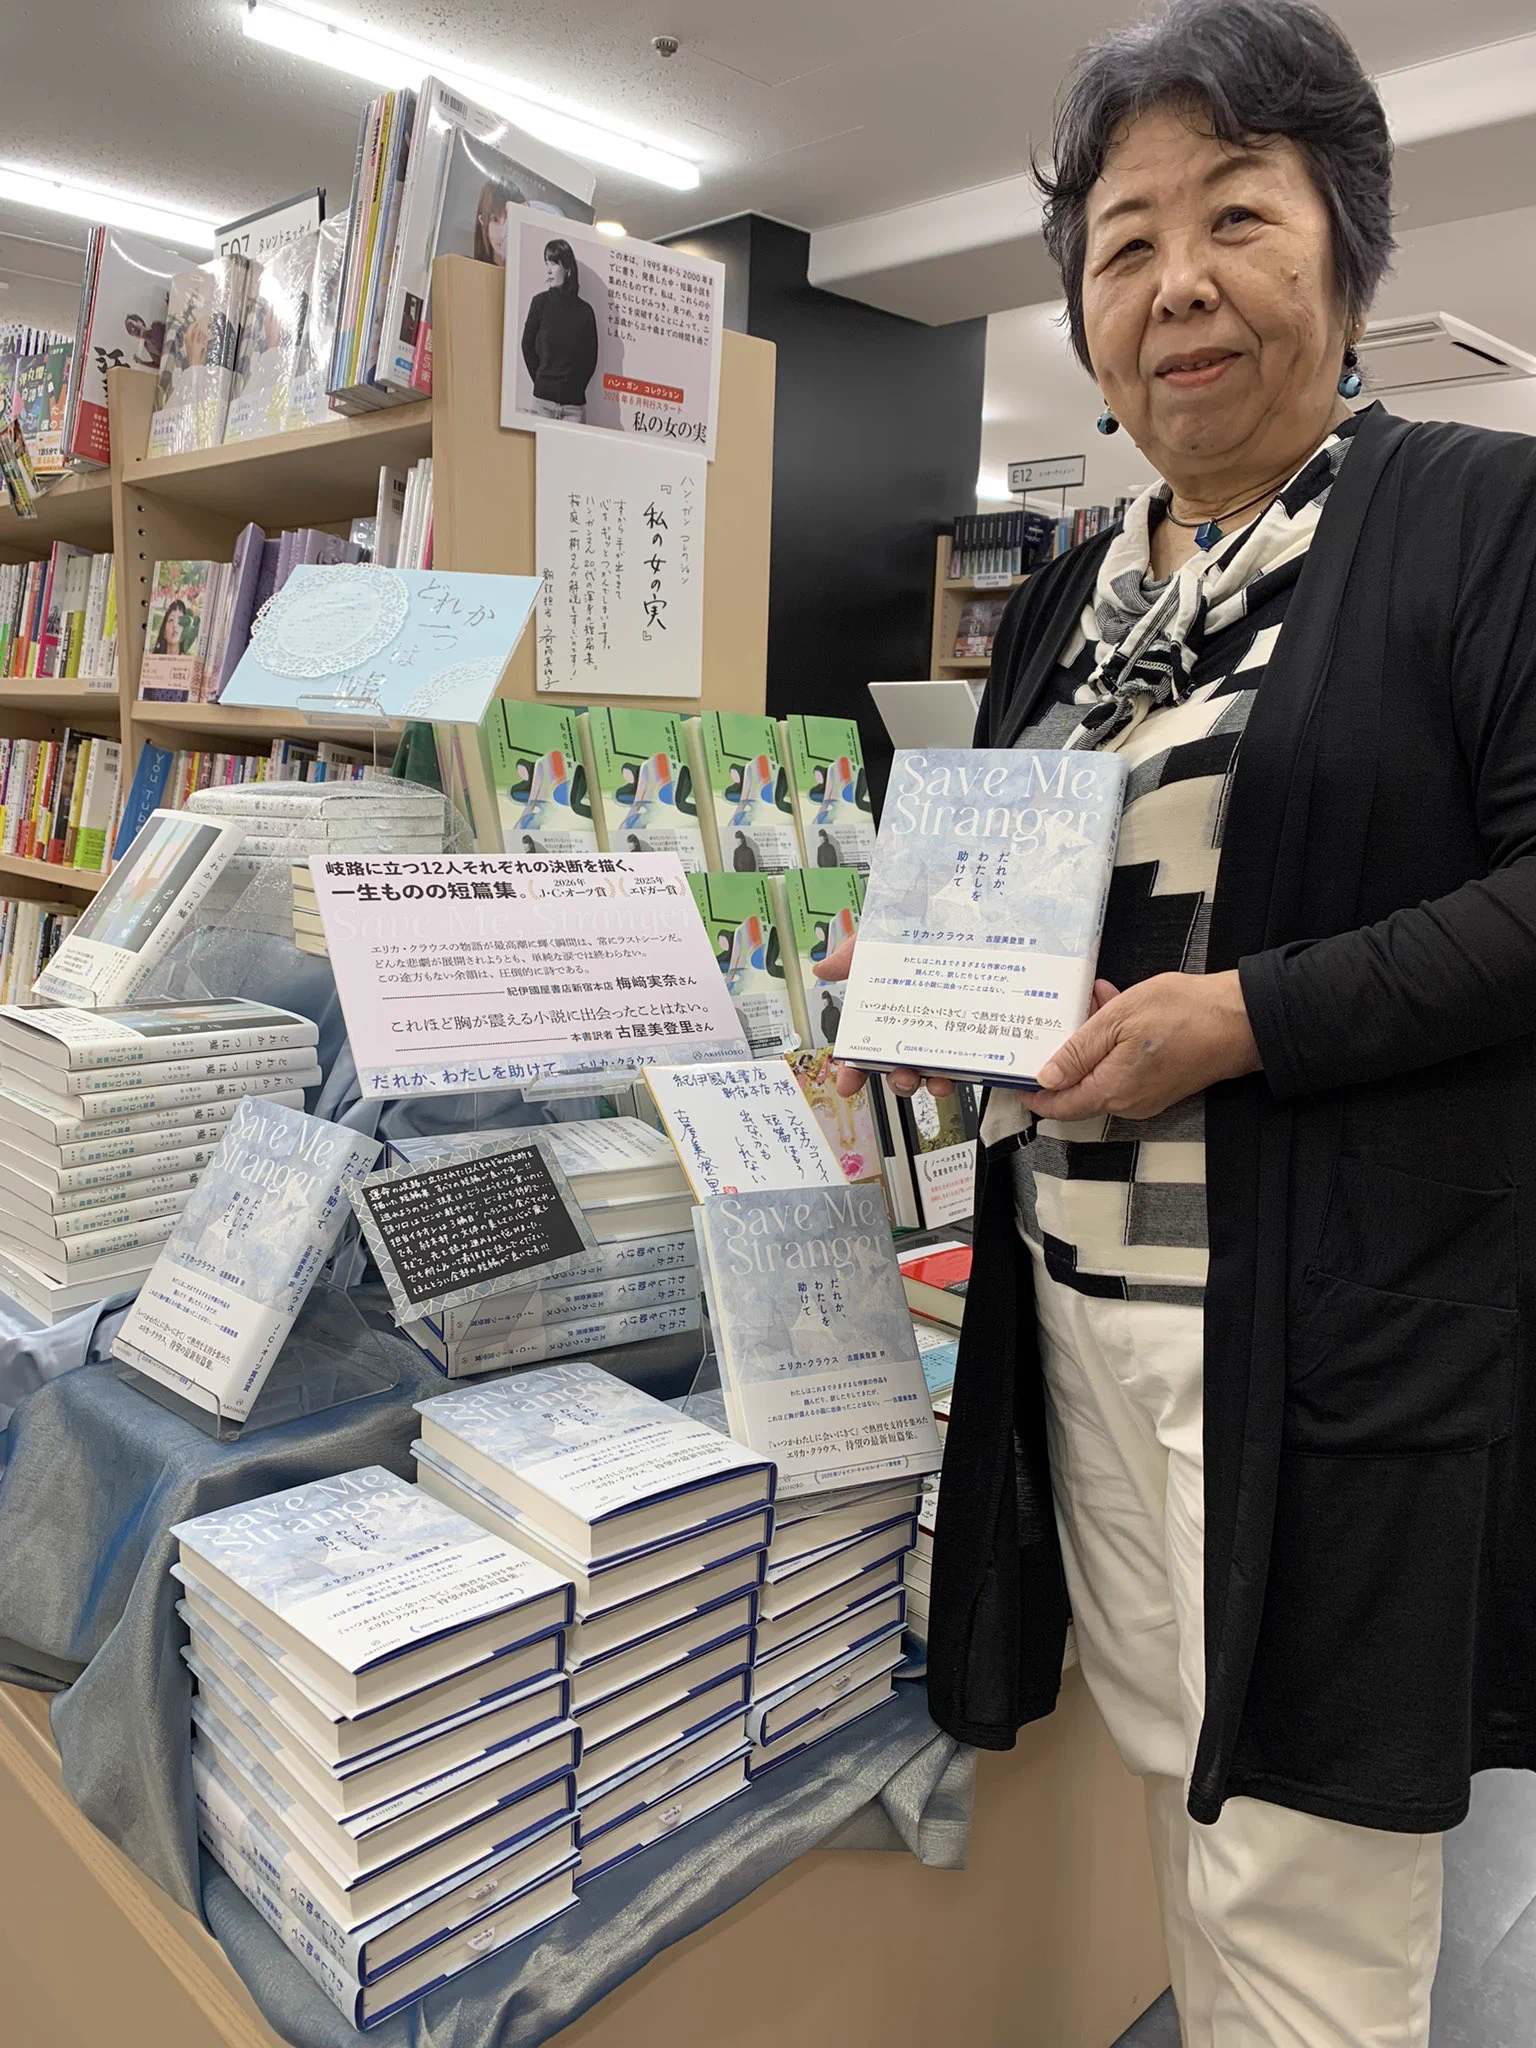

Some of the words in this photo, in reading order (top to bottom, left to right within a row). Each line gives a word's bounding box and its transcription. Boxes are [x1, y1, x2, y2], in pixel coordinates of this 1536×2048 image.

[607, 327, 637, 343] しました。
[608, 378, 639, 391] ハン・ガン
[644, 385, 680, 399] コレクション
[632, 410, 707, 444] 私の女の実
[1012, 468, 1033, 484] E12
[643, 484, 672, 642] 『私の女の実』
[416, 578, 496, 627] どれか
[418, 623, 459, 651] 一つ
[389, 641, 422, 668] は
[899, 755, 1006, 800] Save
[1024, 754, 1104, 801] Me,
[891, 794, 1101, 856] Stranger
[325, 857, 636, 877] 岐路に立つ12人それぞれの決断を描く、
[553, 877, 587, 887] 2026年
[633, 875, 665, 886] 2025年
[953, 850, 970, 888] 助けて
[971, 852, 990, 903] わたしを
[992, 852, 1011, 897] だれか、
[177, 852, 227, 920] どれか一つは嘘
[332, 881, 527, 902] 一生ものの短篇集。
[539, 886, 608, 899] J・C・オーツ賞
[629, 884, 678, 896] エドガー賞
[371, 933, 683, 954] エリカ・クラウスの物語が最高潮に輝く瞬間は、常にラストシーンだ。
[901, 929, 975, 943] エリカ・クラウス
[985, 934, 1025, 945] 古屋美登里
[375, 949, 648, 969] どんな悲劇が展開されようとも、単純な涙では終わらない。
[378, 964, 590, 983] この途方もない余韻は、圧倒的に詩である。
[506, 980, 614, 997] 紀伊國屋書店新宿本店
[391, 1001, 708, 1033] これほど胸が震える小説に出会ったことはない。
[570, 1029, 614, 1043] 本書訳者
[615, 1020, 714, 1039] 古屋美登里さん
[371, 1061, 557, 1090] だれか、わたしを助けて
[672, 1066, 767, 1088] 紀伊國屋書店
[722, 1084, 771, 1100] 新宿本店
[775, 1079, 796, 1097] 様
[230, 1100, 290, 1150] Save
[288, 1117, 334, 1172] Me,
[739, 1110, 771, 1161] 出ないかも
[673, 1109, 721, 1196] 古屋美登里
[734, 1136, 766, 1184] しれない
[213, 1135, 323, 1207] Stranger
[223, 1190, 241, 1224] 助けて
[227, 1195, 250, 1239] わたしを
[241, 1198, 262, 1239] だれか、
[720, 1198, 813, 1239] Save
[616, 1241, 686, 1259] わたしを助けて
[726, 1232, 888, 1282] Stranger
[287, 1249, 323, 1313] エリカ・クラウス
[617, 1275, 686, 1293] わたしを助けて
[797, 1281, 812, 1317] 助けて
[815, 1280, 831, 1327] わたしを
[831, 1278, 847, 1320] だれか、
[619, 1307, 687, 1327] わたしを助けて
[778, 1356, 840, 1372] エリカ・クラウス
[431, 1381, 536, 1416] Save
[191, 1493, 313, 1537] Save
[211, 1487, 412, 1556] Stranger
[315, 1534, 343, 1553] 助けて
[336, 1529, 370, 1552] わたしを
[355, 1522, 388, 1542] だれか、
[321, 1561, 397, 1589] エリカ・クラウス
